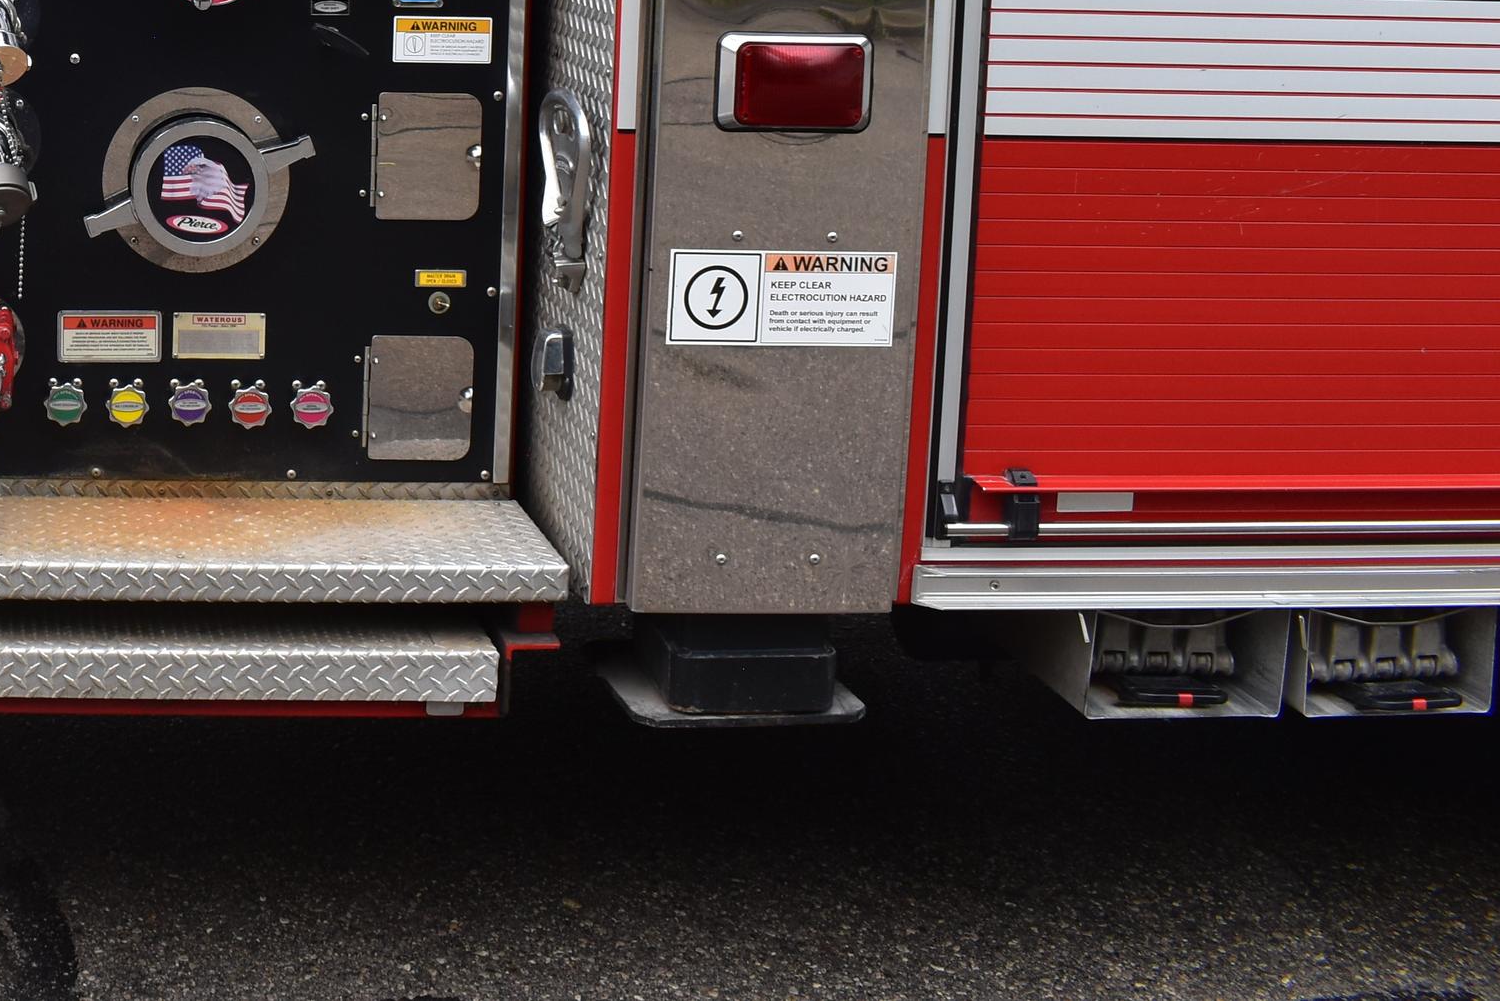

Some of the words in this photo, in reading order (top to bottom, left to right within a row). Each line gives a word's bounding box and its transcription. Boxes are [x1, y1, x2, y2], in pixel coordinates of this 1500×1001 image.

[421, 21, 477, 31] WARNING
[177, 216, 217, 230] Pierce
[792, 256, 889, 272] WARNING
[770, 281, 797, 289] KEEP
[798, 281, 832, 290] CLEAR
[770, 293, 847, 302] ELECTROCUTION
[849, 294, 887, 303] HAZARD
[825, 310, 844, 318] injury
[90, 318, 144, 328] WARNING
[827, 318, 863, 326] equipment
[799, 326, 835, 334] electrically
[836, 326, 865, 334] charged.
